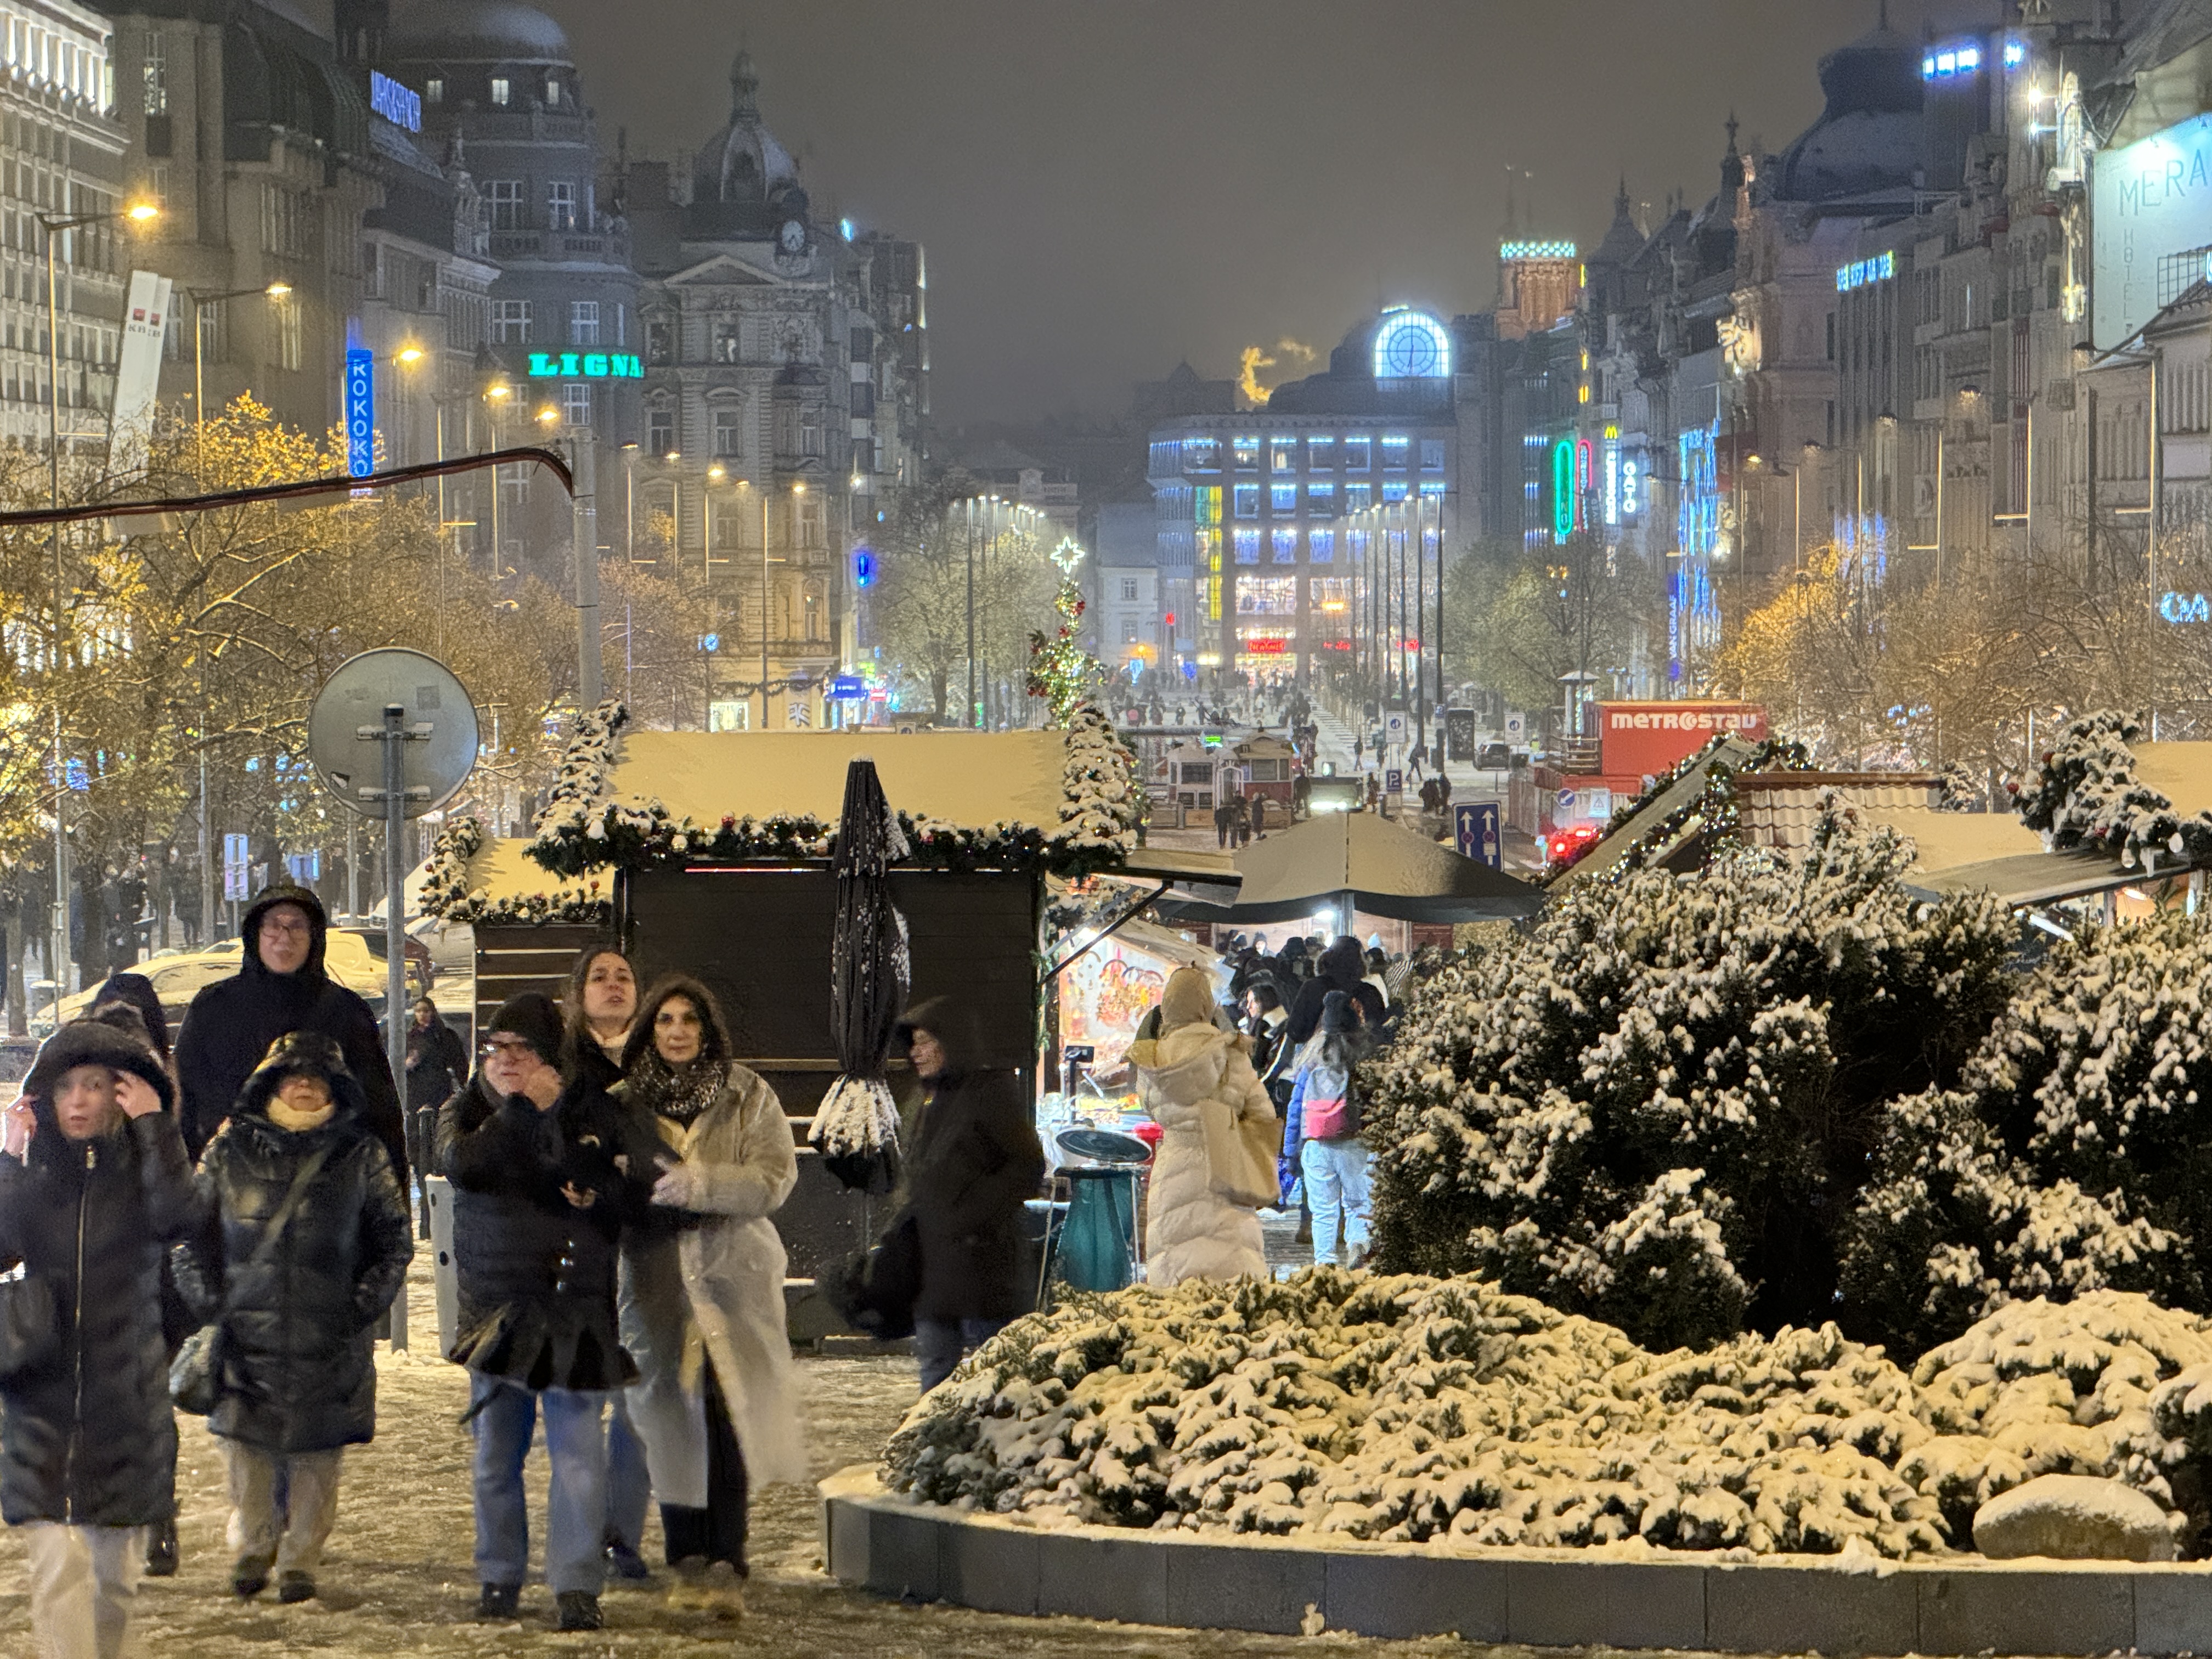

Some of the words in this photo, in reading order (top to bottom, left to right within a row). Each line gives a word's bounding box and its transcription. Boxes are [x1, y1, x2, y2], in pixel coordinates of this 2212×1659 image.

[128, 324, 146, 334] KB
[528, 353, 644, 378] LIGNA
[353, 359, 368, 477] KOKOKO
[1389, 772, 1399, 786] P
